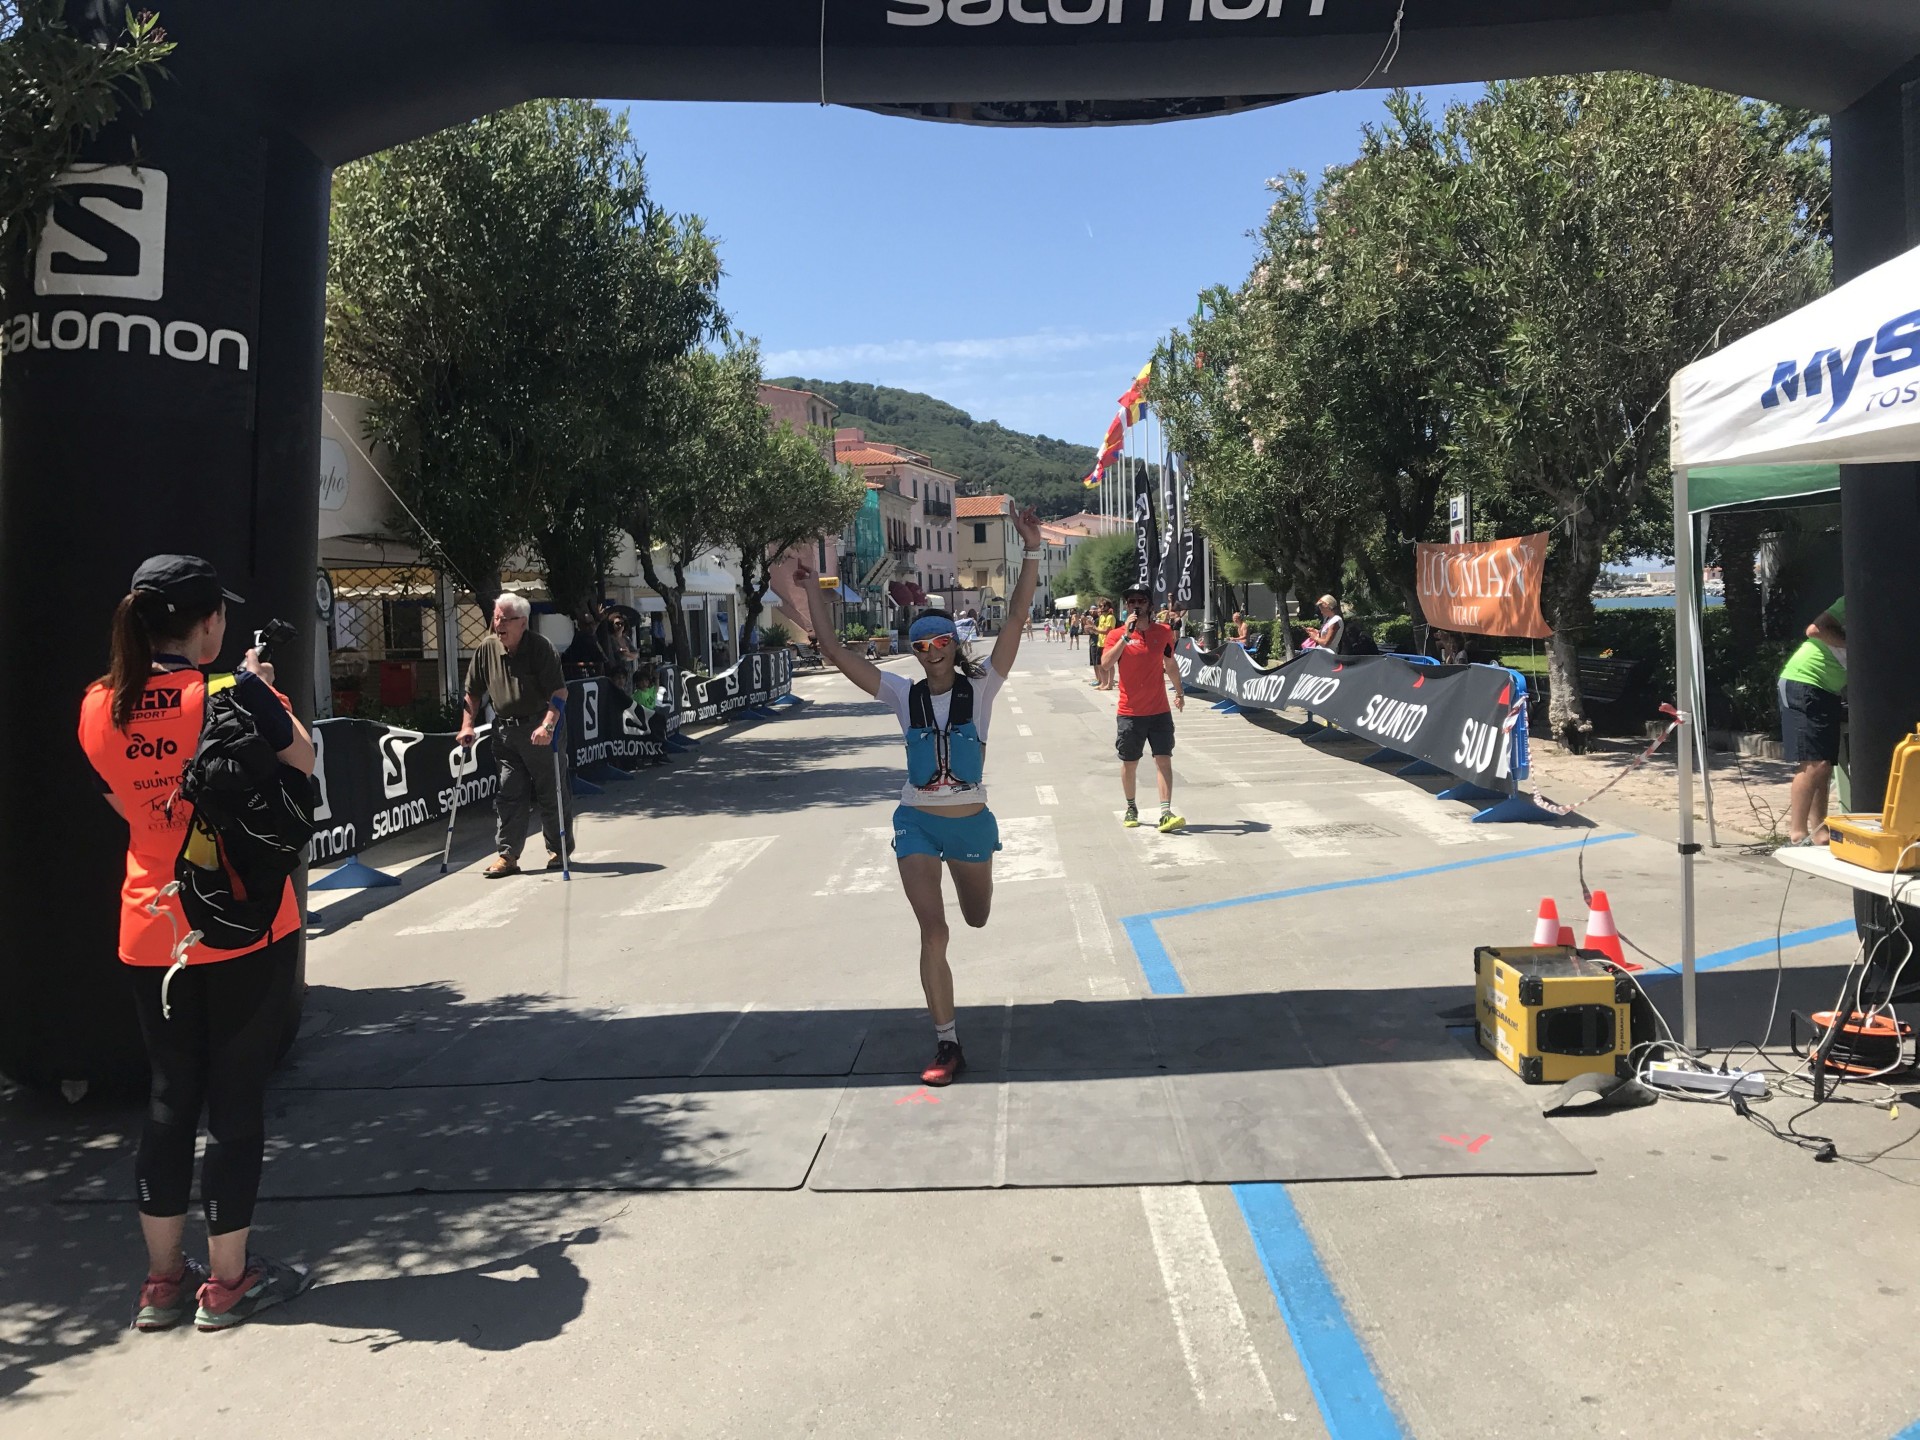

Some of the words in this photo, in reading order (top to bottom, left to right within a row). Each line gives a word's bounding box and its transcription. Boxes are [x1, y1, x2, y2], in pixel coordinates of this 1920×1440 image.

[1422, 545, 1529, 598] LOCMAN
[1242, 674, 1286, 703] SUUNTO
[1357, 694, 1428, 743] SUUNTO
[126, 737, 178, 760] eolo
[371, 797, 430, 841] salomon
